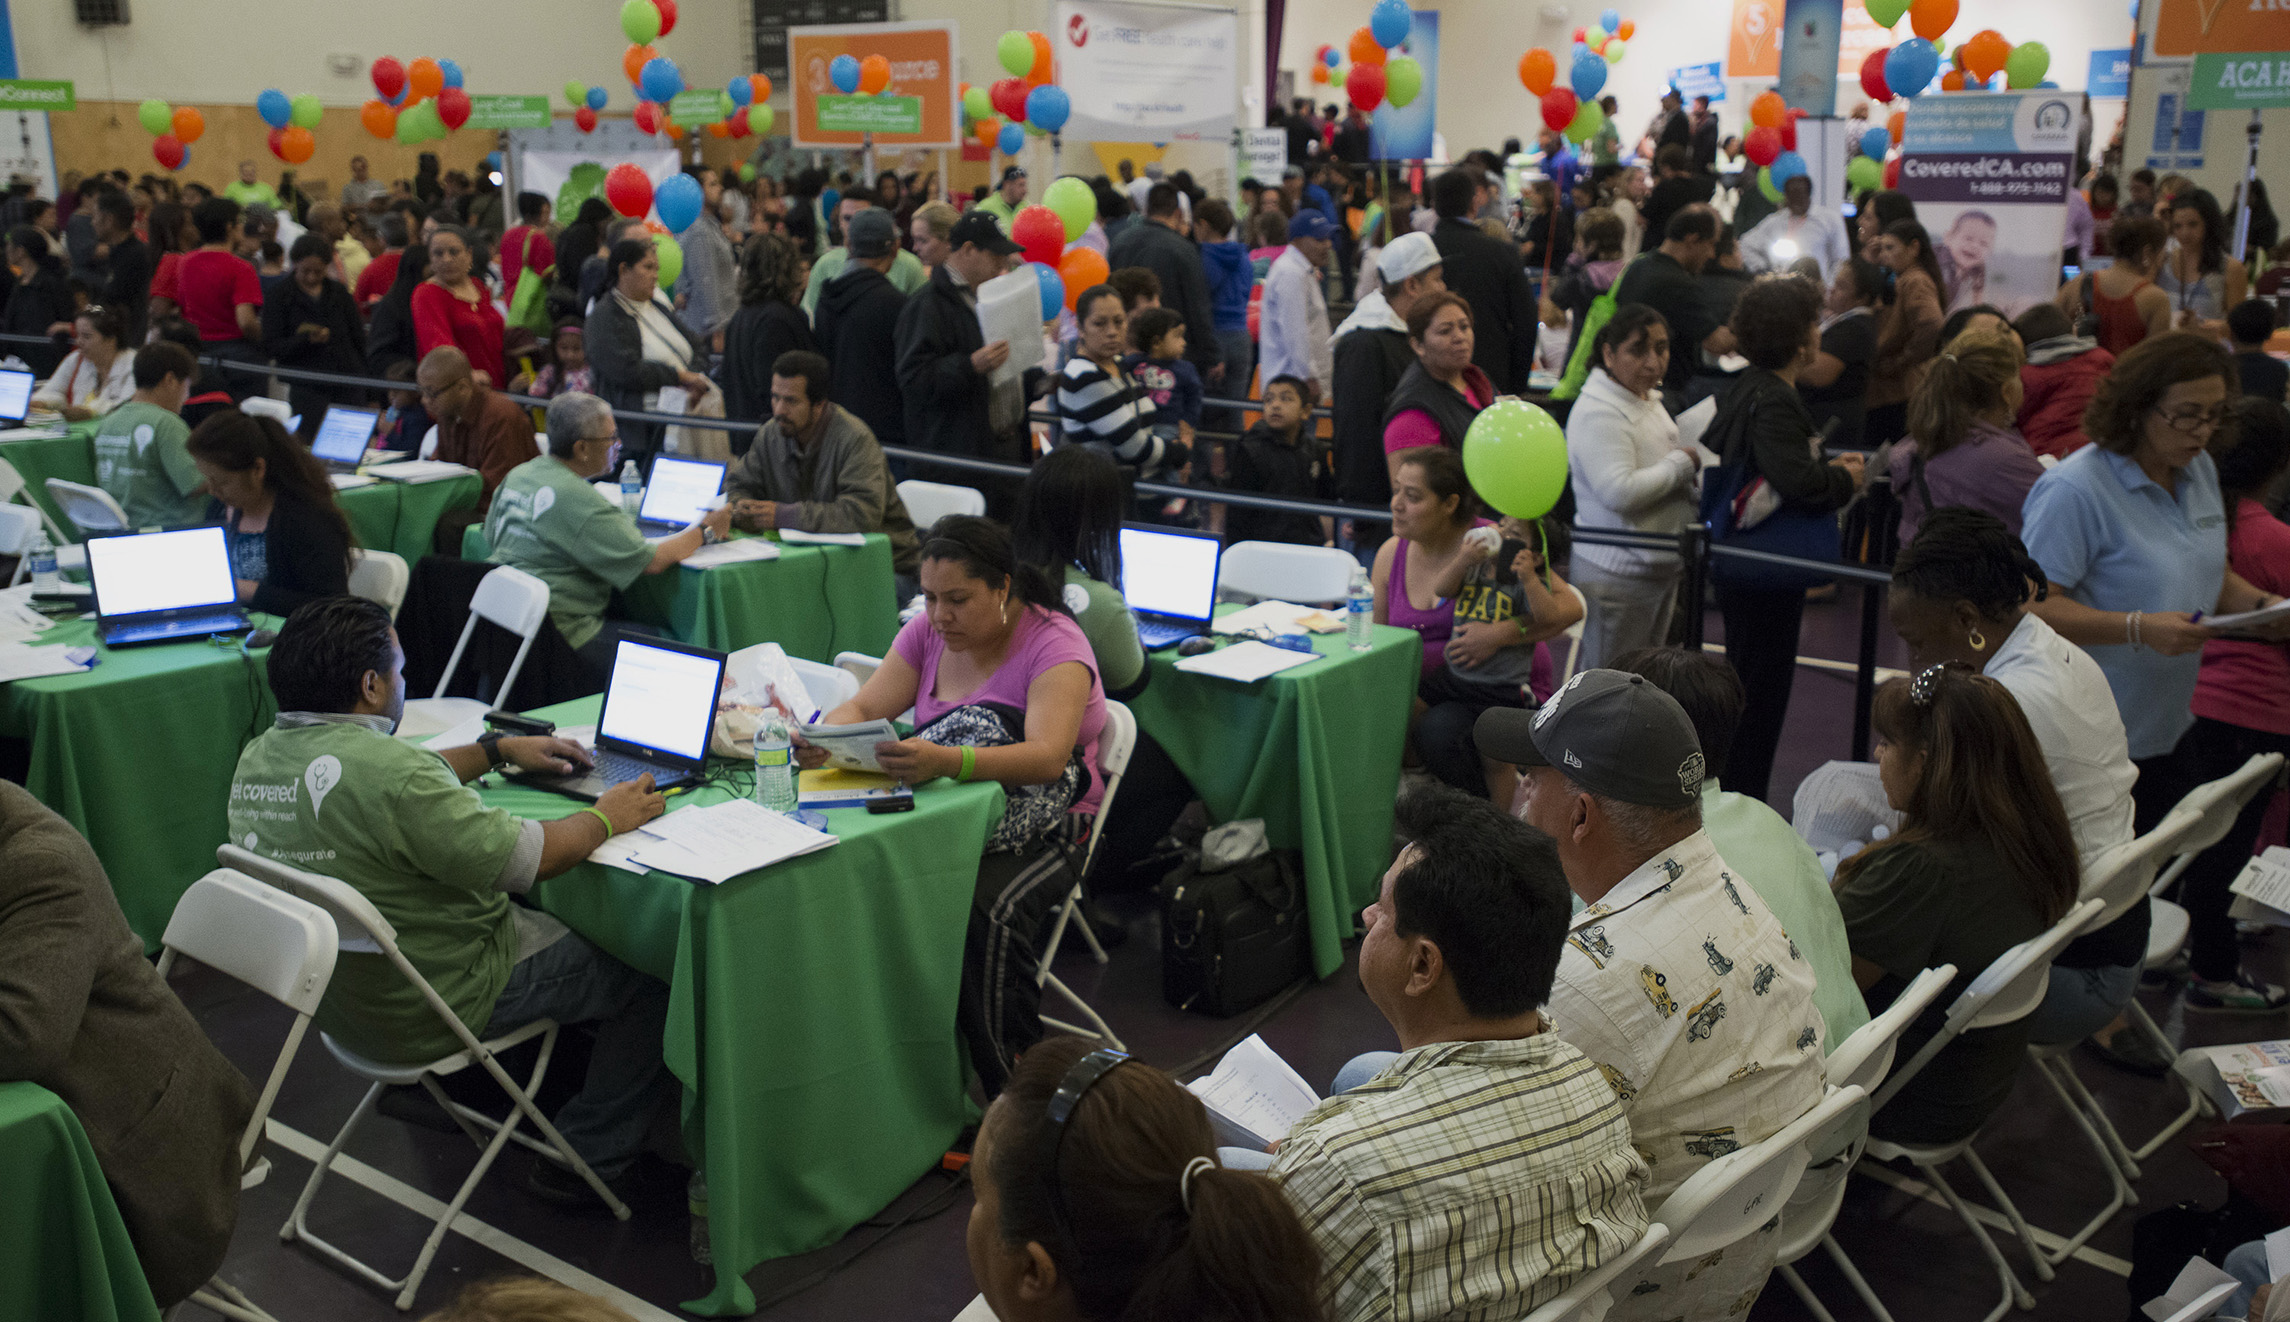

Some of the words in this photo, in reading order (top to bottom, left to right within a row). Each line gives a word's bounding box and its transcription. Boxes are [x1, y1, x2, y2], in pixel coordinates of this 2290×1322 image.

[1746, 4, 1766, 35] 5
[809, 56, 827, 95] 3
[2217, 60, 2271, 88] ACA
[1904, 157, 2065, 178] CoveredCA.com
[1970, 181, 2063, 196] 1-888-975-1142
[1681, 762, 1705, 779] WORLD
[242, 777, 299, 803] covered
